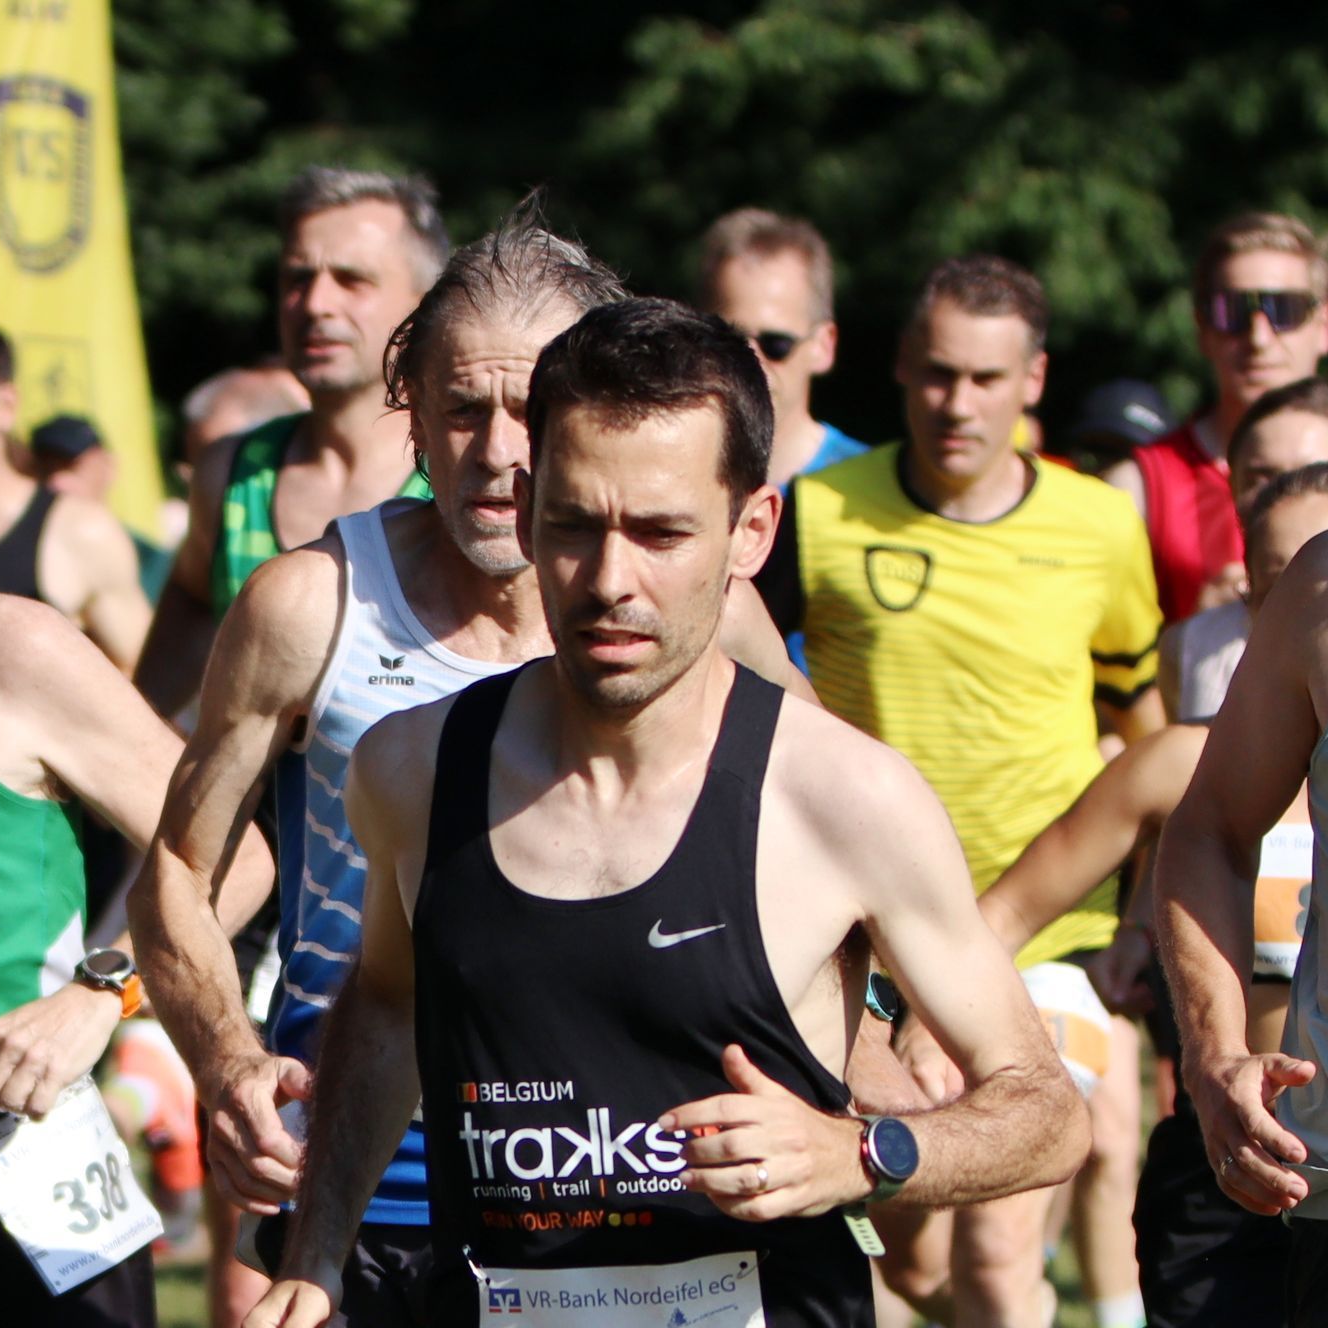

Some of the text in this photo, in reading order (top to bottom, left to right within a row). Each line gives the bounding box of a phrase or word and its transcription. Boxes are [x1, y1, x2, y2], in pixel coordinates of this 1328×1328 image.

[368, 673, 415, 686] erima
[479, 1080, 574, 1103] BELGIUM
[459, 1107, 687, 1180] trakks
[473, 1176, 686, 1202] running trail outdoo
[514, 1211, 563, 1231] YOUR
[566, 1210, 605, 1228] WAY
[526, 1274, 736, 1309] VR-Bank Nordeifel eG
